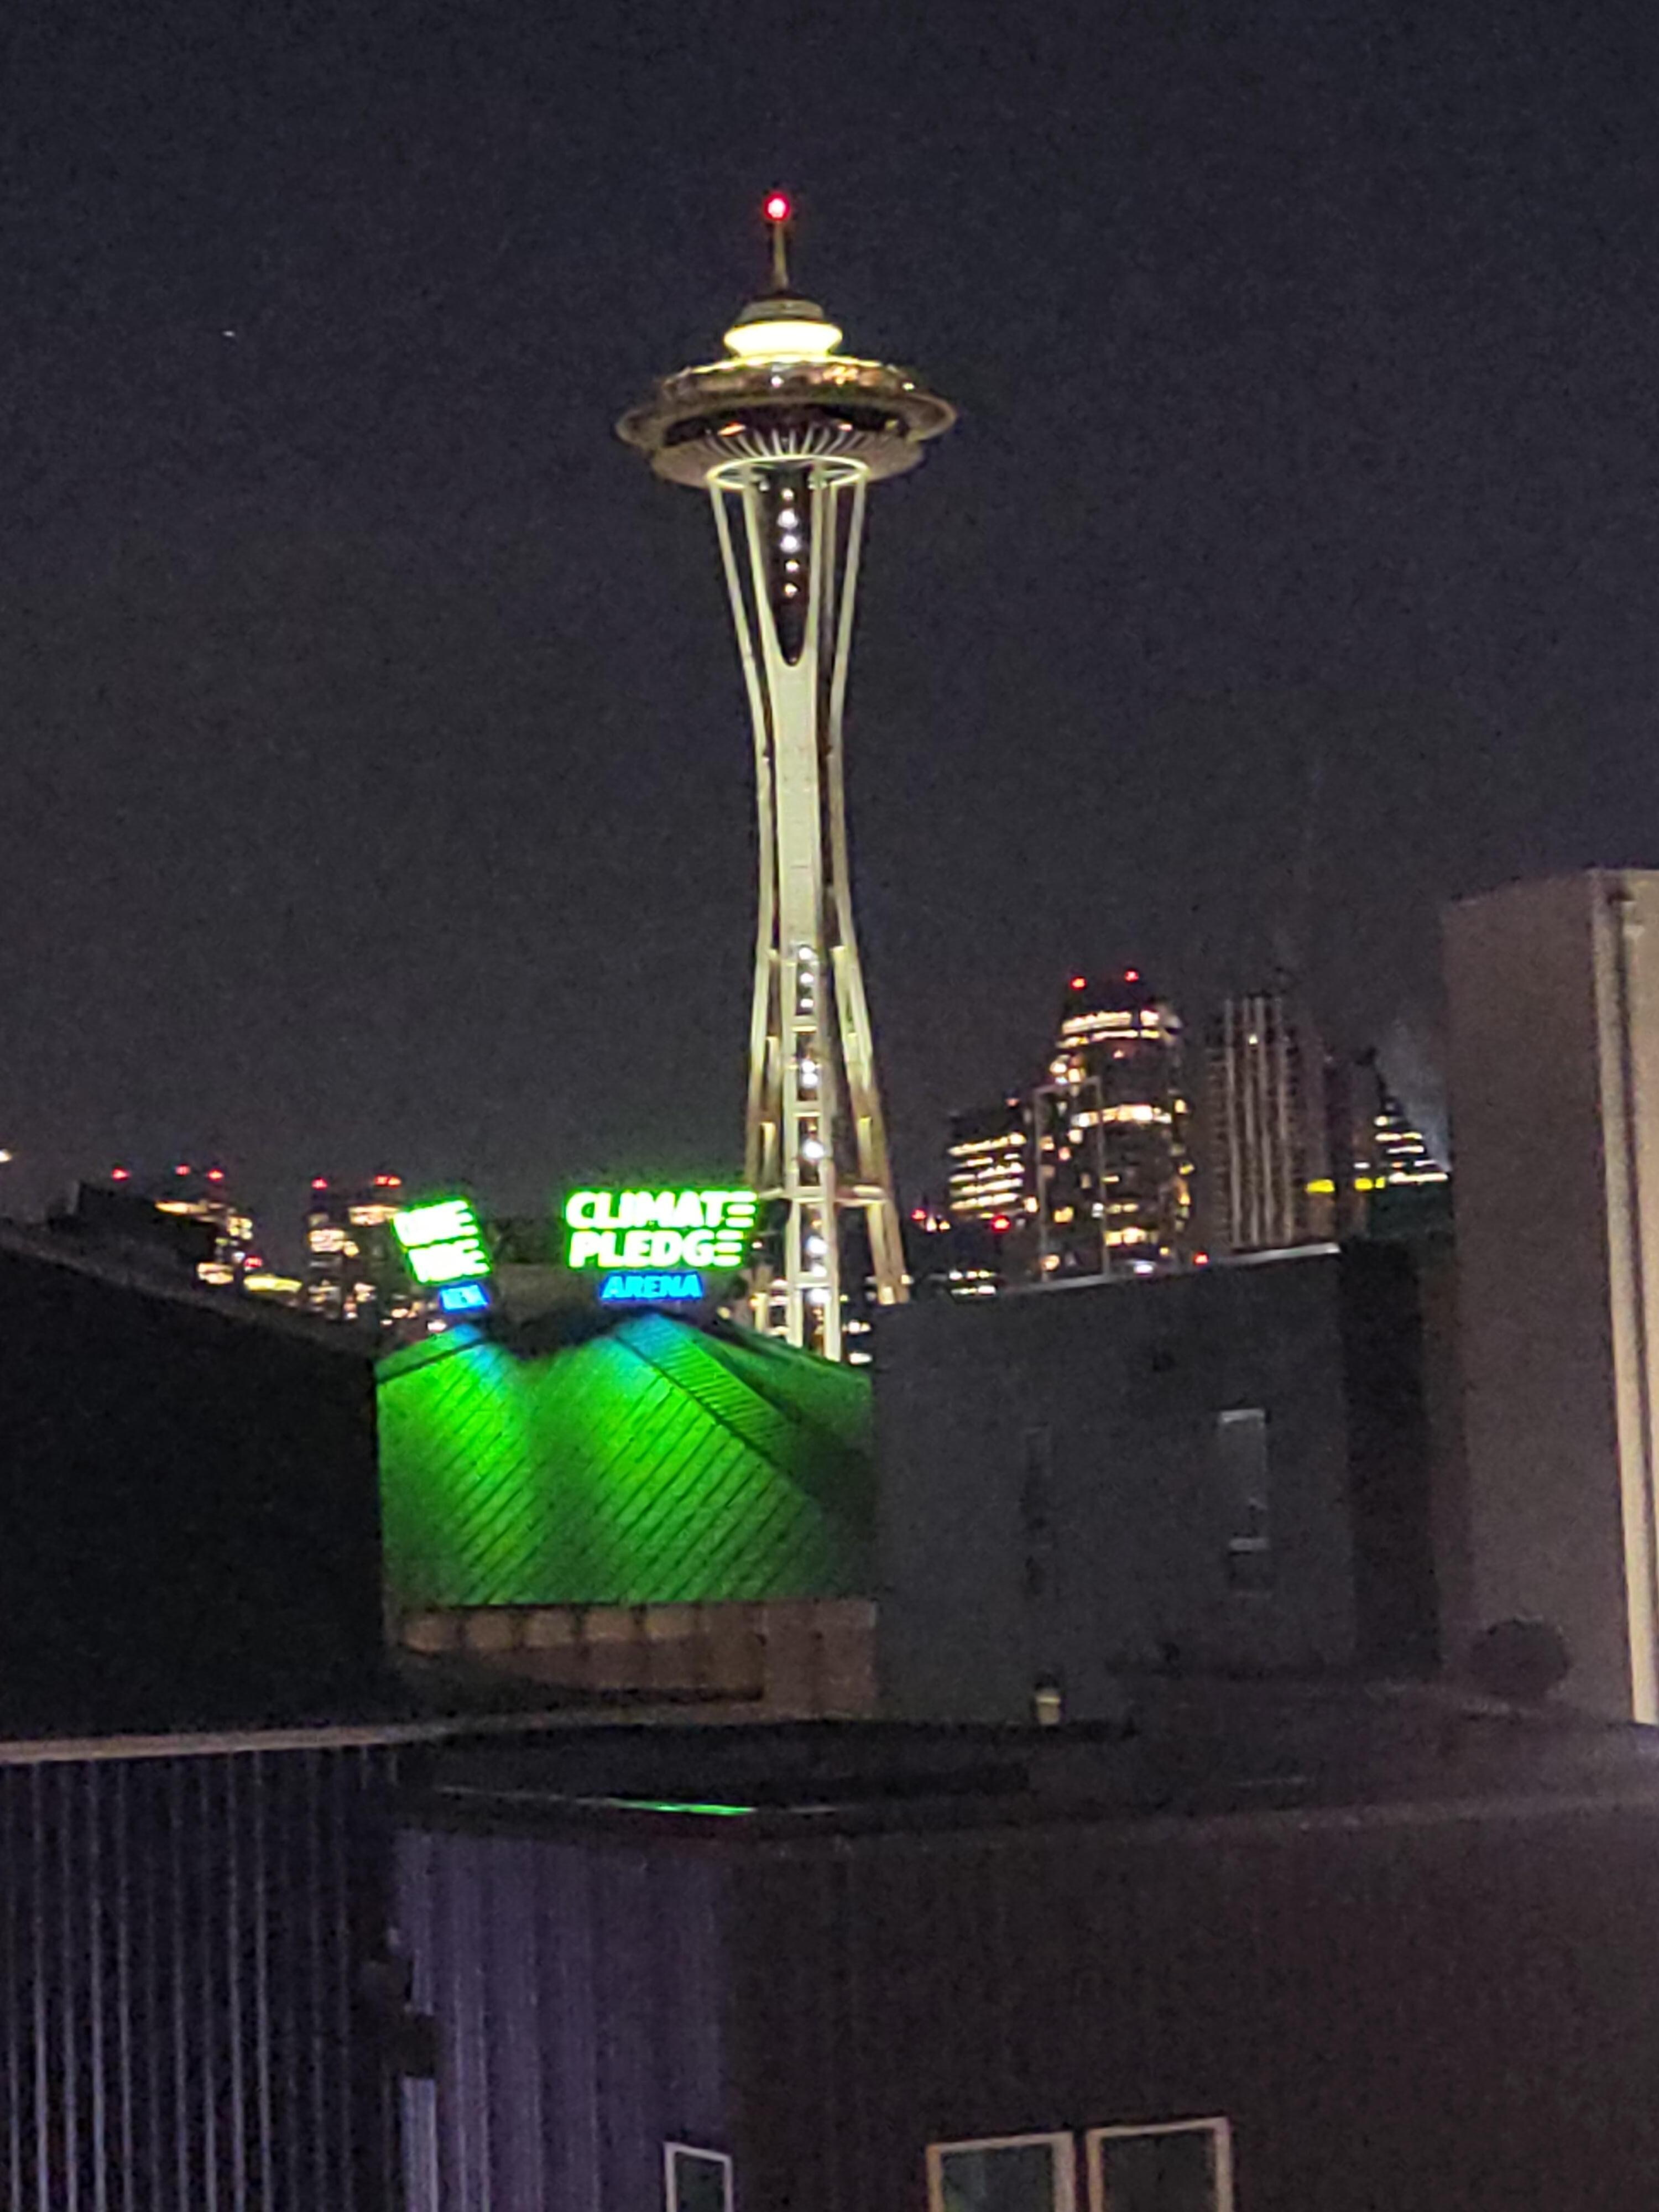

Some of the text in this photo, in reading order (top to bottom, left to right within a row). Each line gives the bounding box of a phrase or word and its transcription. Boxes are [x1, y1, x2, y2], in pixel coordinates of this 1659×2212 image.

[565, 1190, 758, 1229] CLIMATE
[568, 1229, 744, 1268] PLEDGE
[601, 1274, 703, 1299] ARENA
